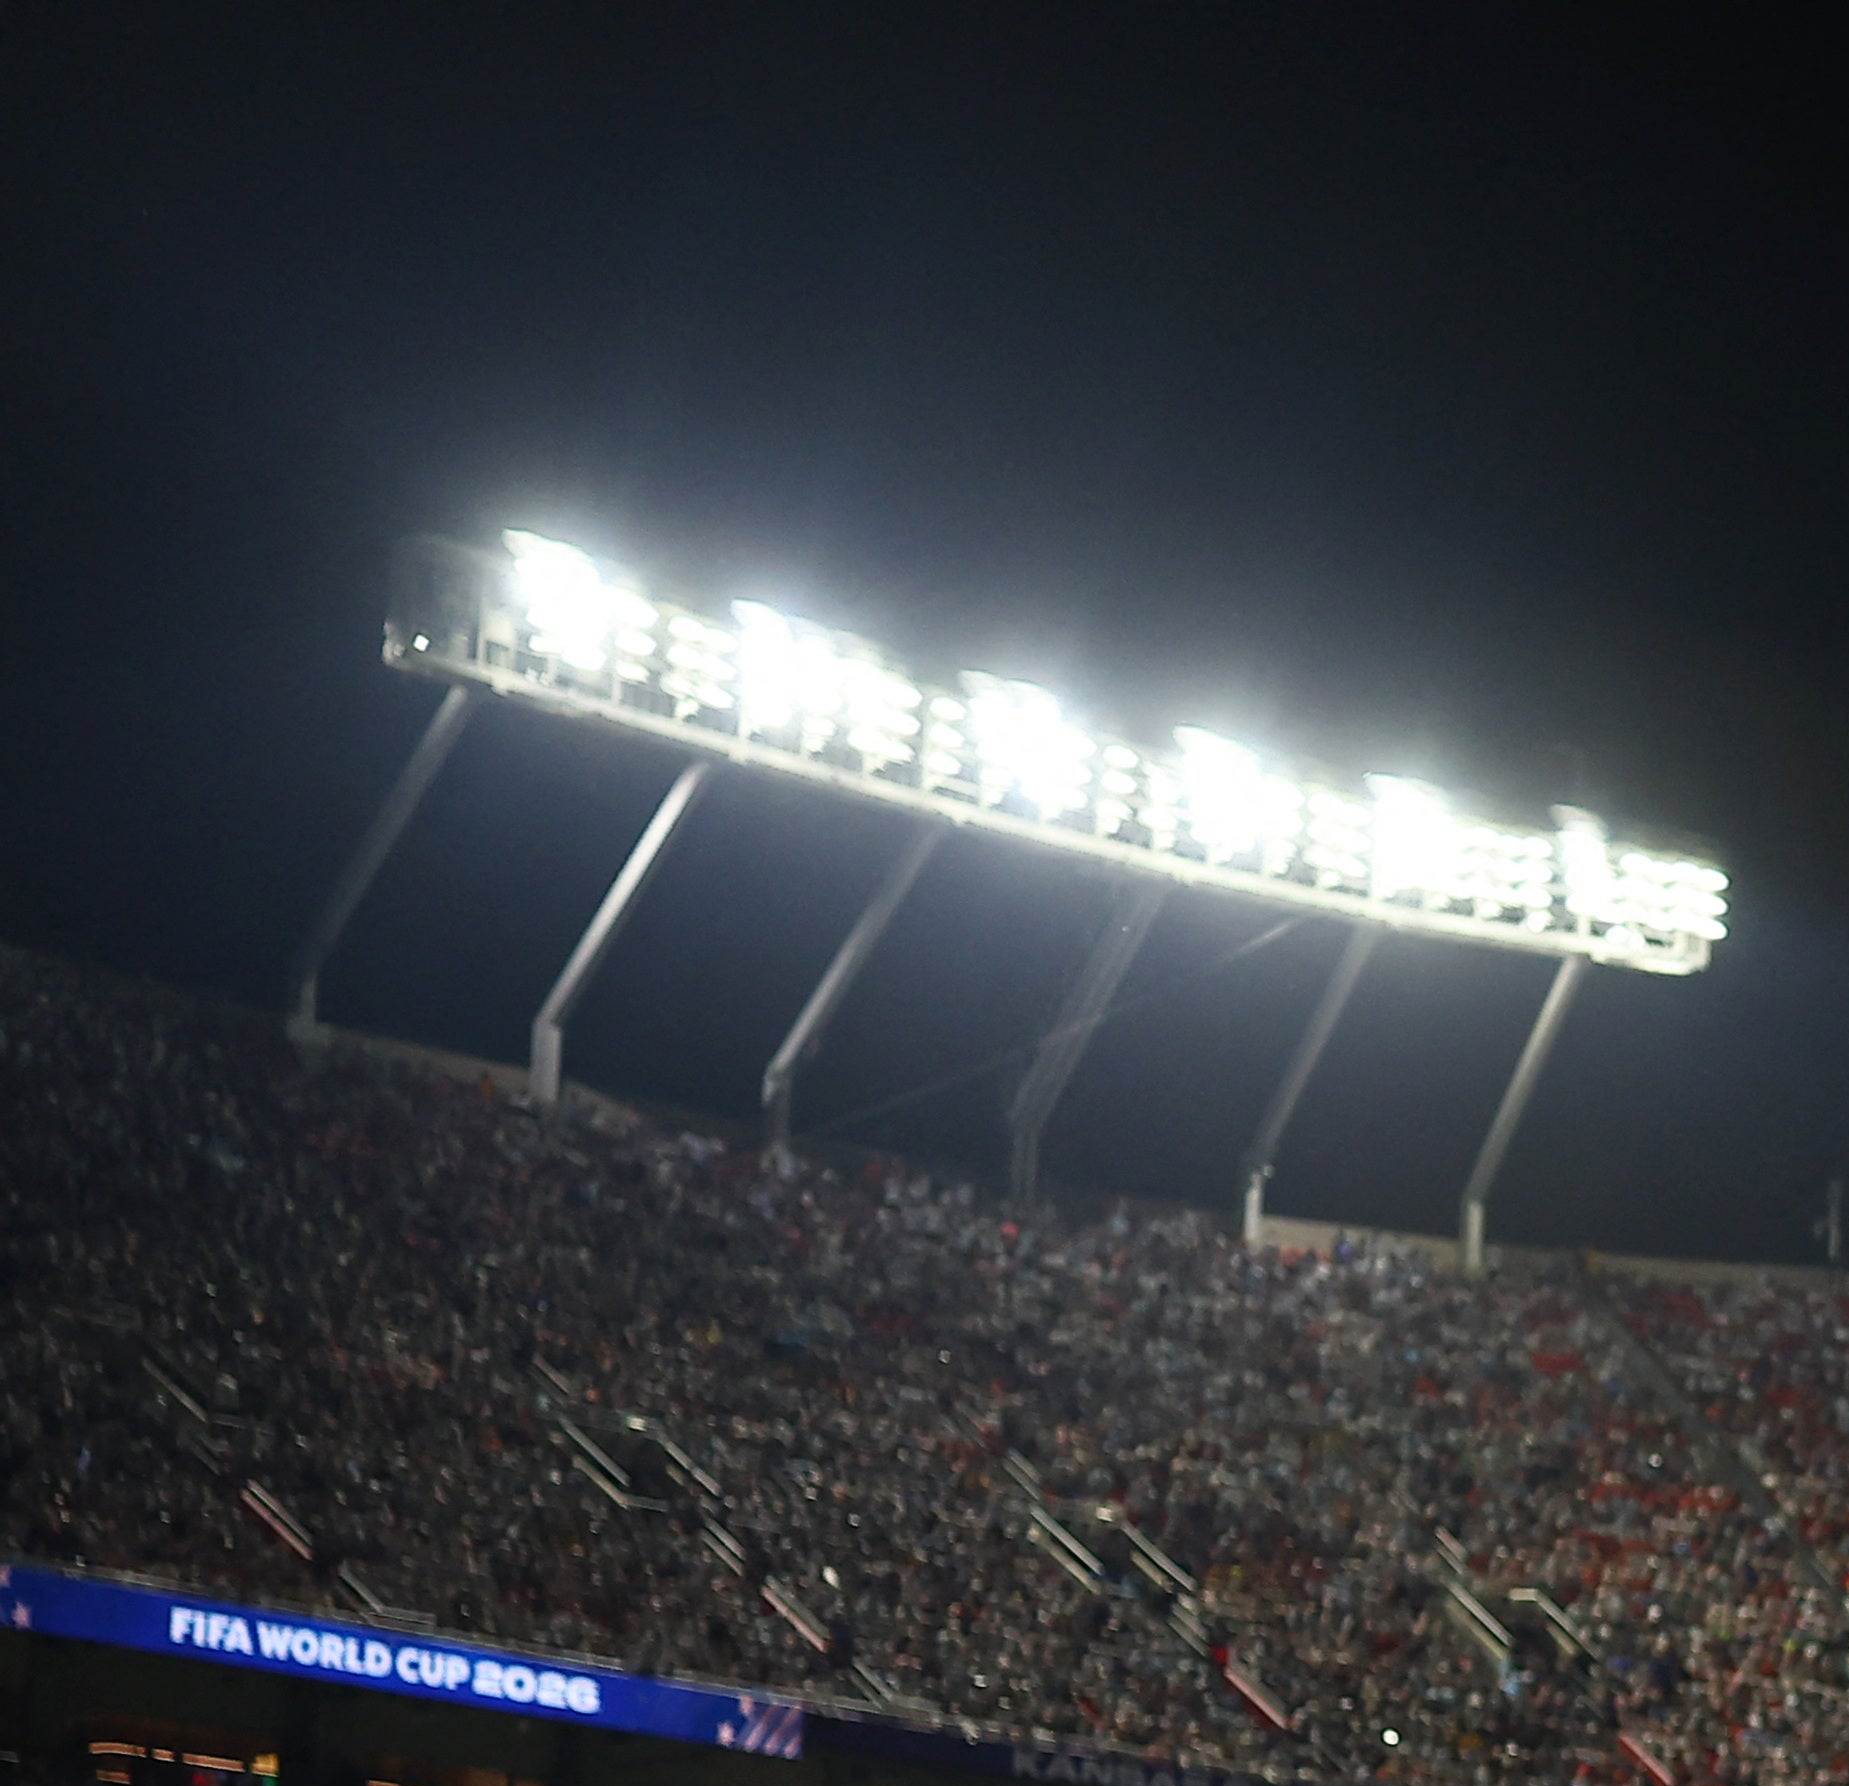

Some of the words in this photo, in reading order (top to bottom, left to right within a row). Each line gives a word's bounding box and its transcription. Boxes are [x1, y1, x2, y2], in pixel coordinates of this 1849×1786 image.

[170, 1606, 253, 1656] FIFA
[256, 1621, 392, 1678] WORLD
[395, 1647, 470, 1691] CUP
[472, 1660, 601, 1714] 2026
